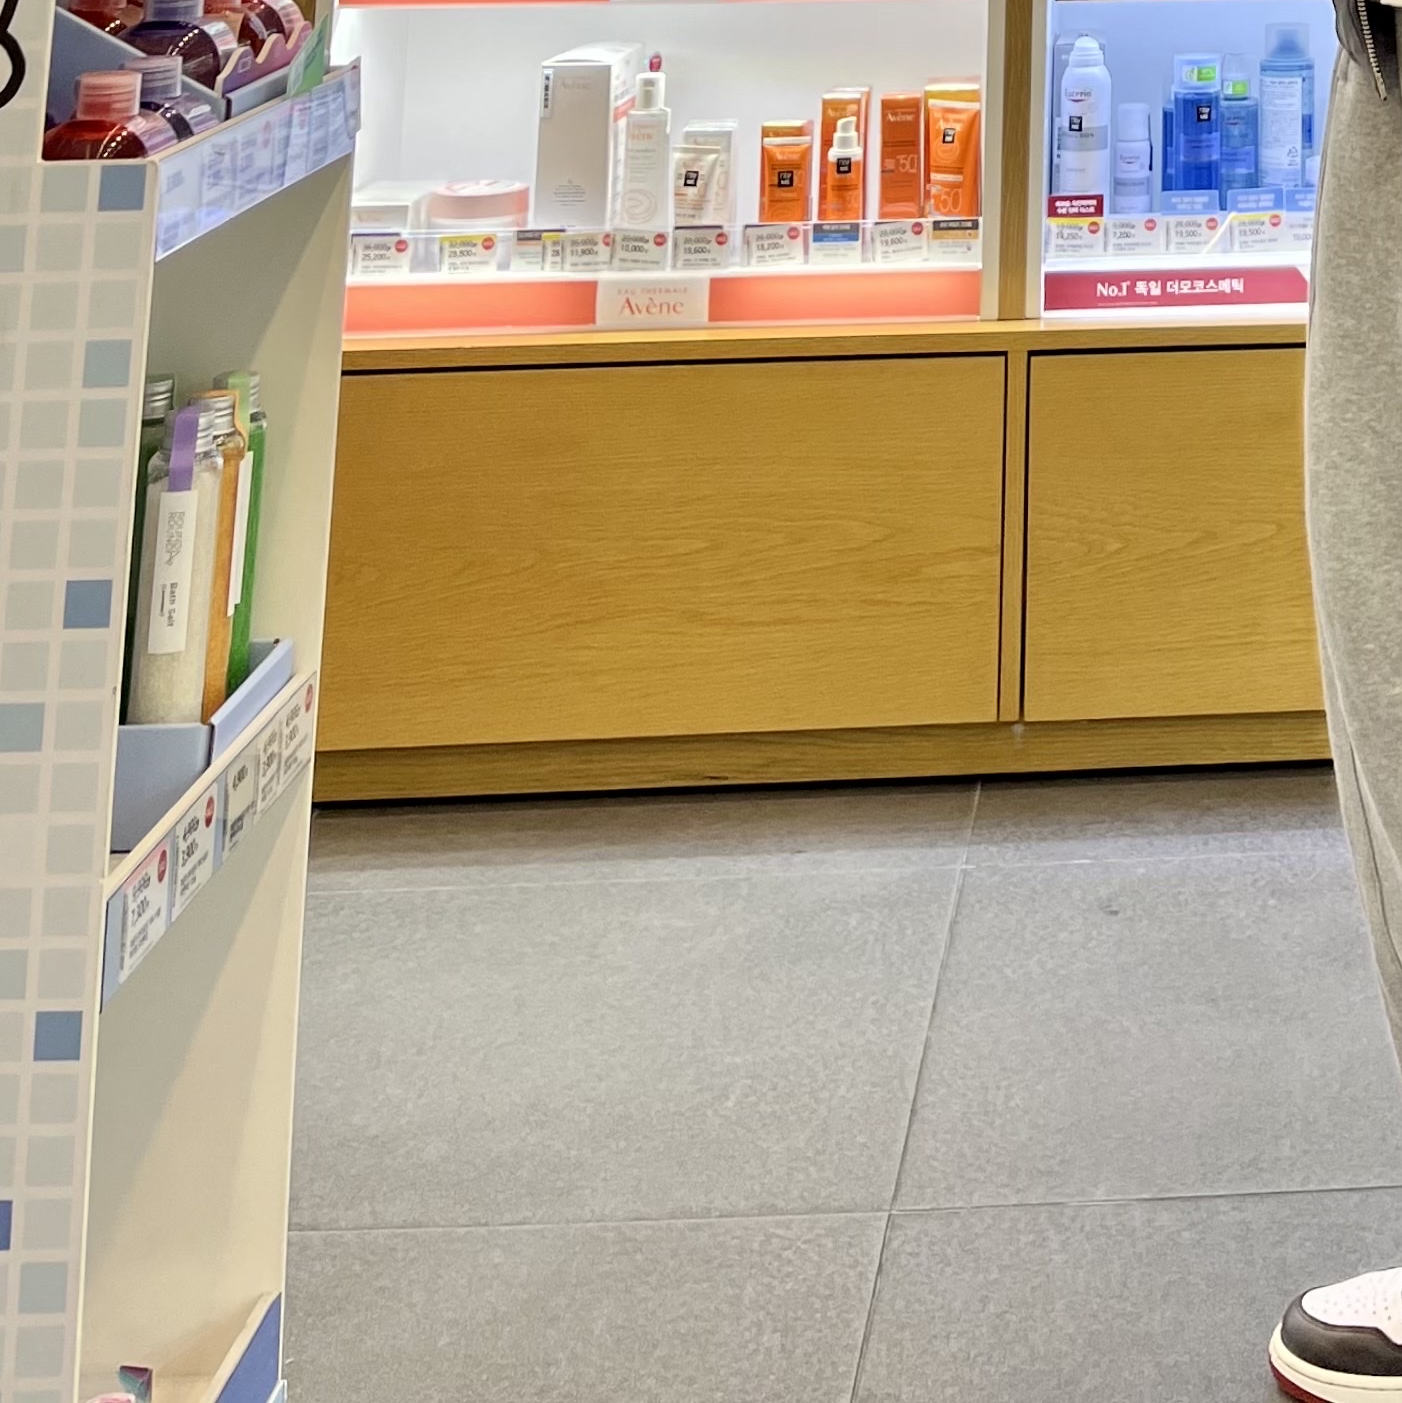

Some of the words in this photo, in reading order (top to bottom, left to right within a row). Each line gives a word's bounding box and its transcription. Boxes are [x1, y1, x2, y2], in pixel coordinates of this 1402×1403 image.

[1134, 280, 1162, 296] 독일
[619, 294, 685, 316] Avène
[169, 581, 179, 606] Bath
[166, 607, 176, 628] Salt
